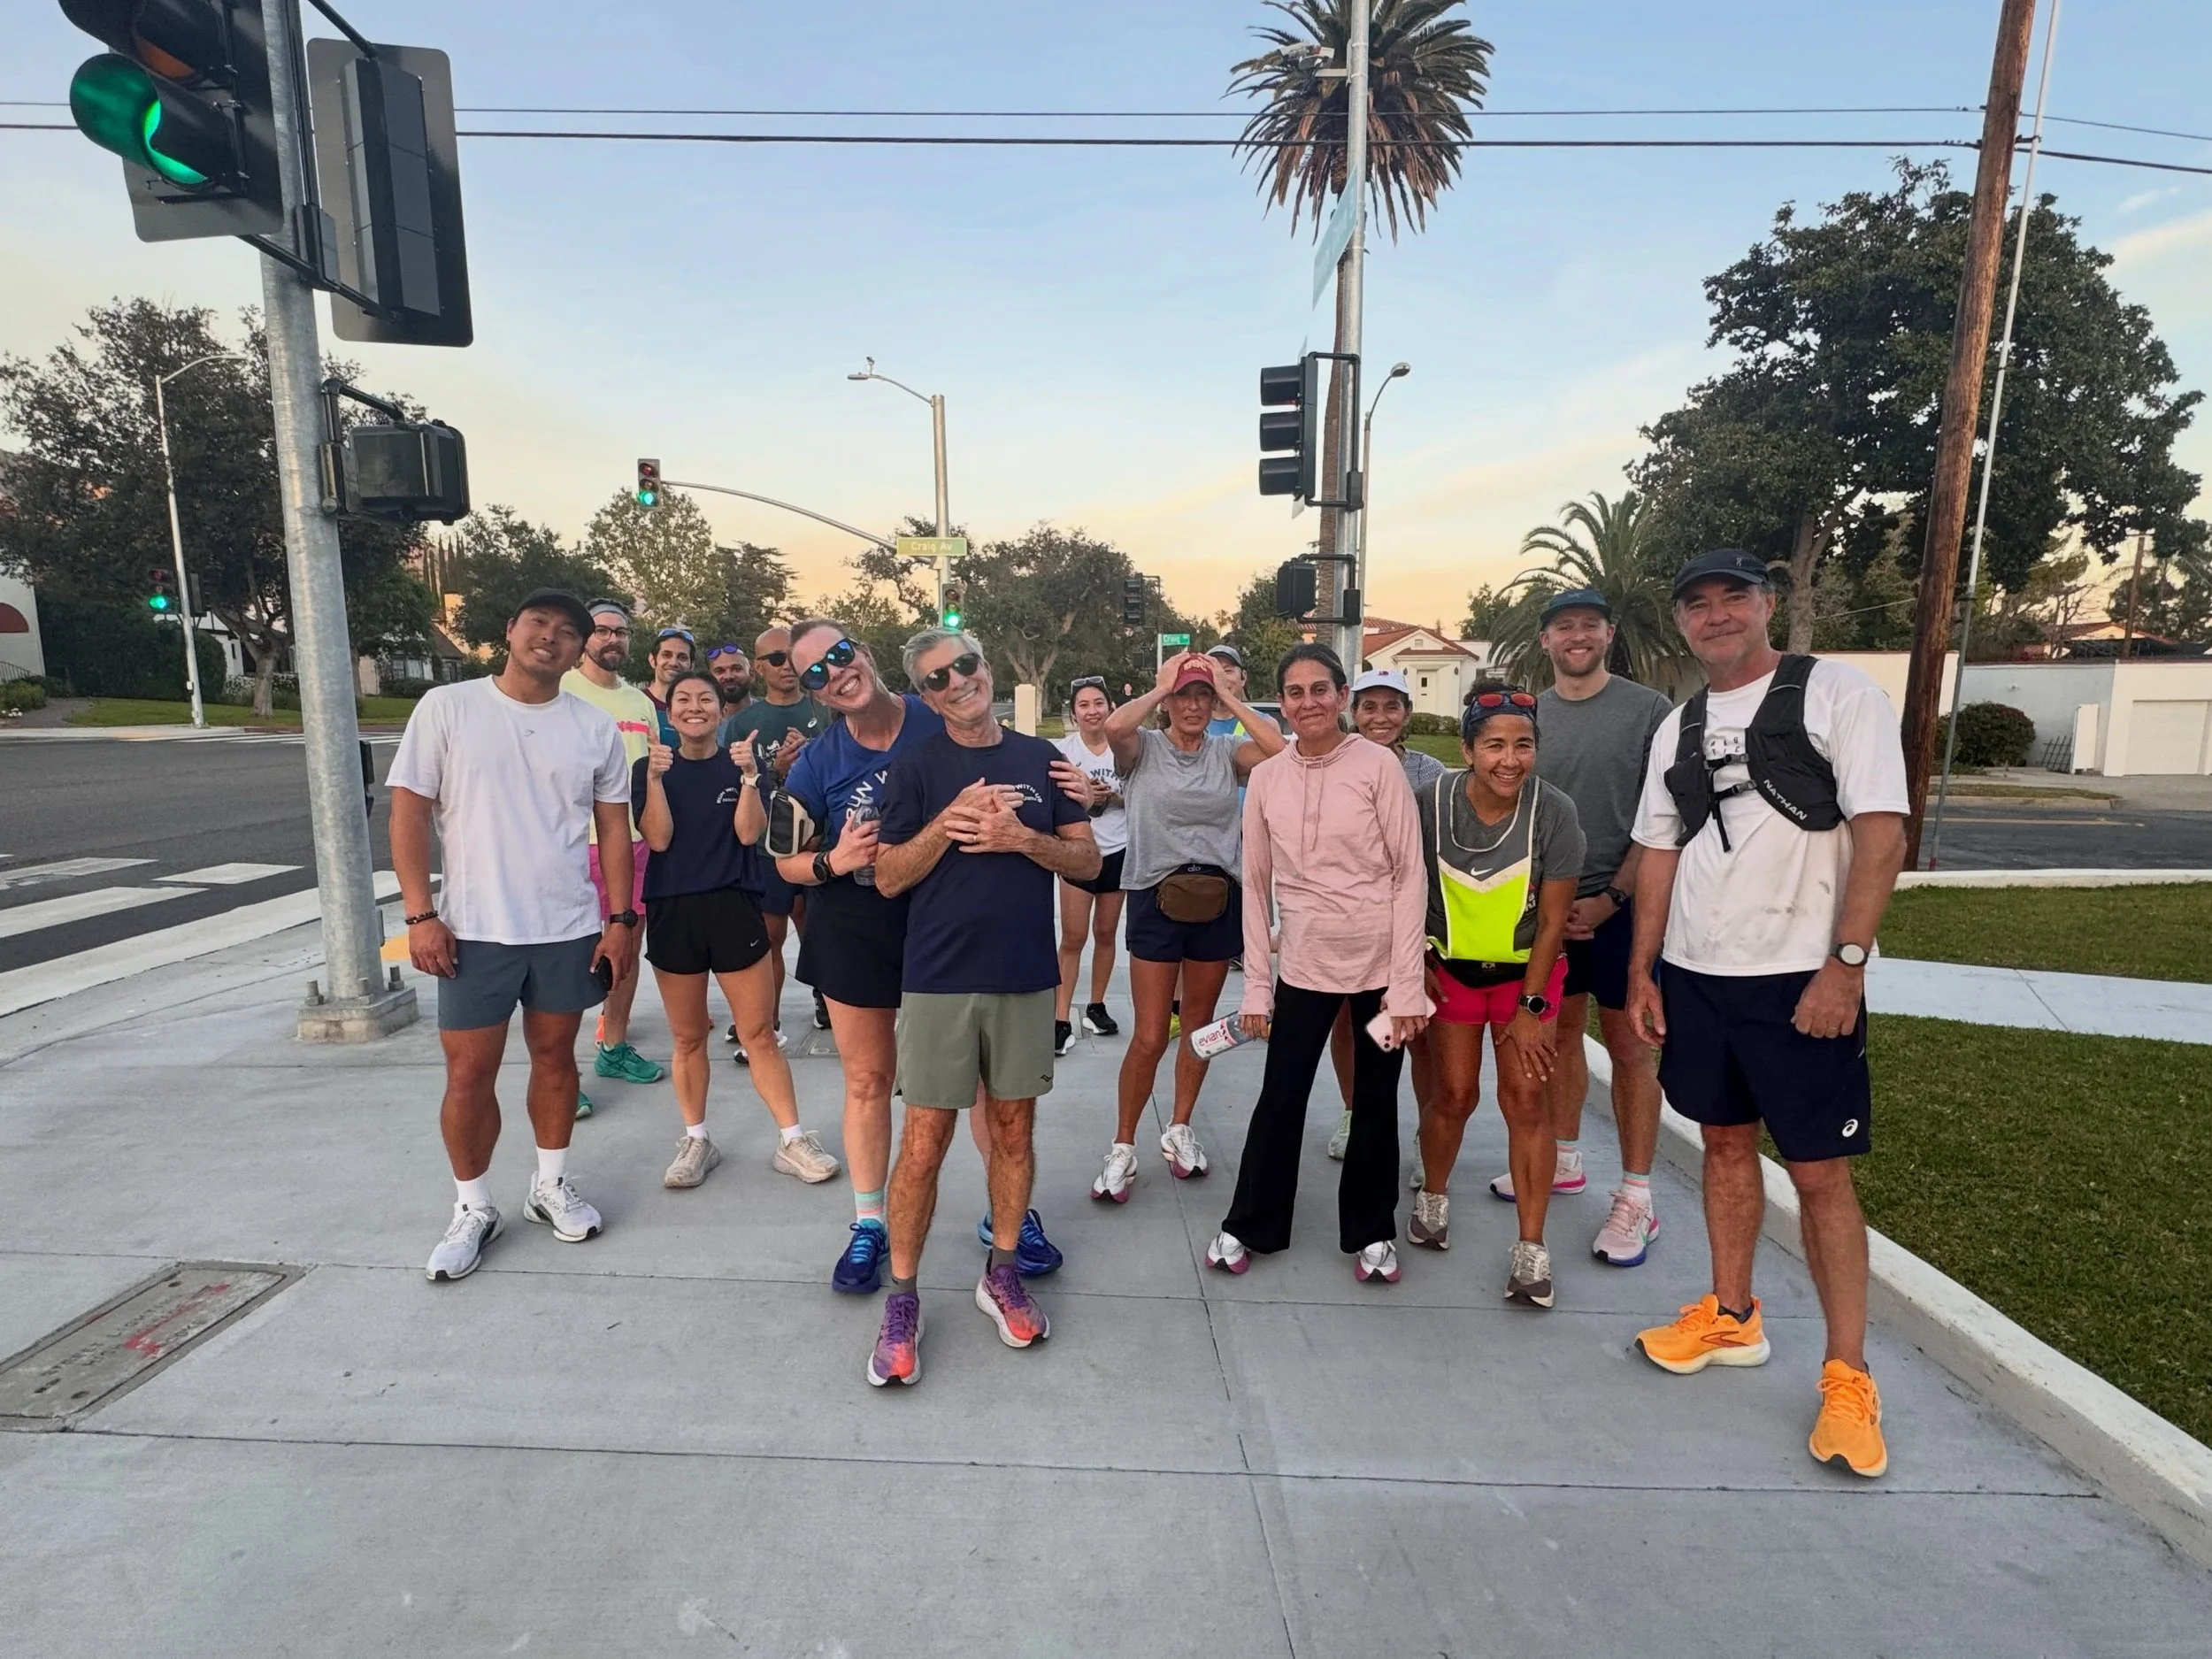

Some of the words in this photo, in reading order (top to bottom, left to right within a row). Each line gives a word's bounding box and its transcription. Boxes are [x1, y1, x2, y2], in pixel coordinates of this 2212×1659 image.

[910, 541, 936, 552] Craig
[940, 541, 953, 550] Av
[1015, 784, 1035, 794] WITH
[1763, 780, 1808, 820] NATHAN
[1187, 864, 1202, 872] alo
[1199, 1030, 1222, 1047] evian
